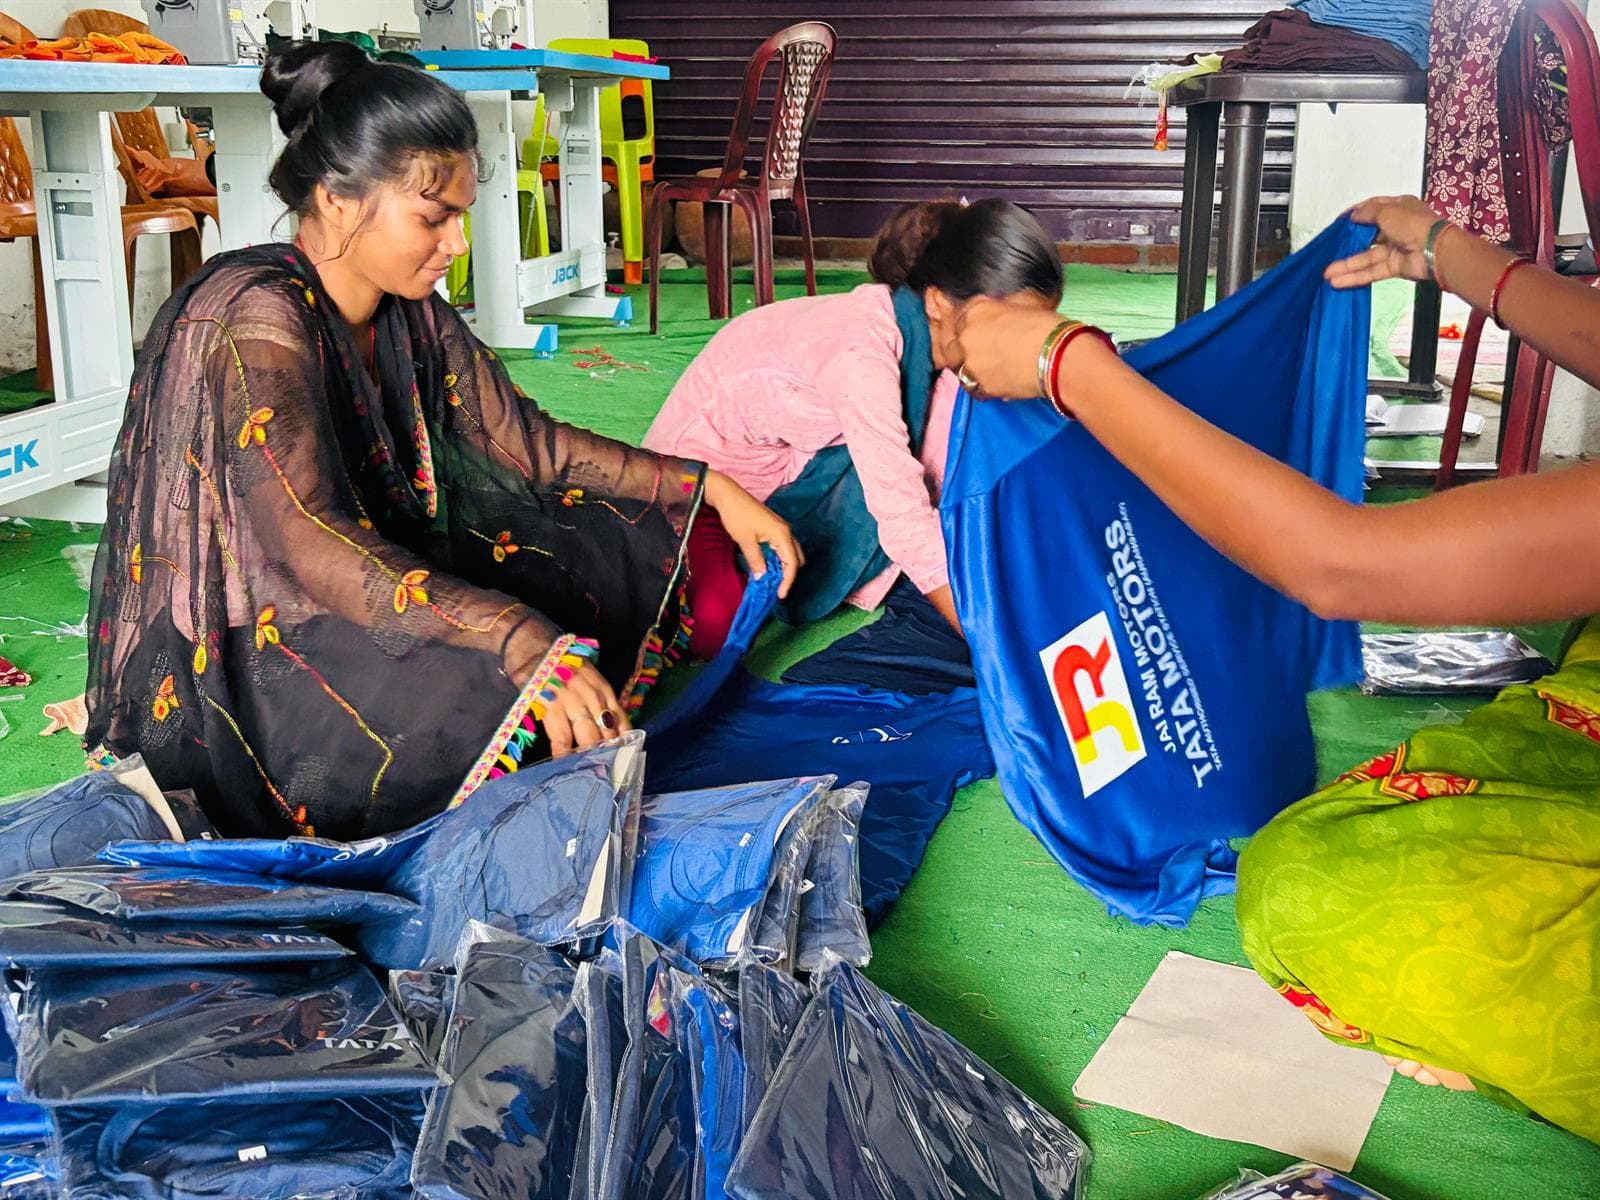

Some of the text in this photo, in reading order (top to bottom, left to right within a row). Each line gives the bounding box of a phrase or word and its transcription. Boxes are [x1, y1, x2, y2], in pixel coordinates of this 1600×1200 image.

[1105, 519, 1213, 788] TATA MOTORS
[1107, 571, 1177, 753] JAI RAM MOTORS
[316, 1037, 403, 1050] TATA
